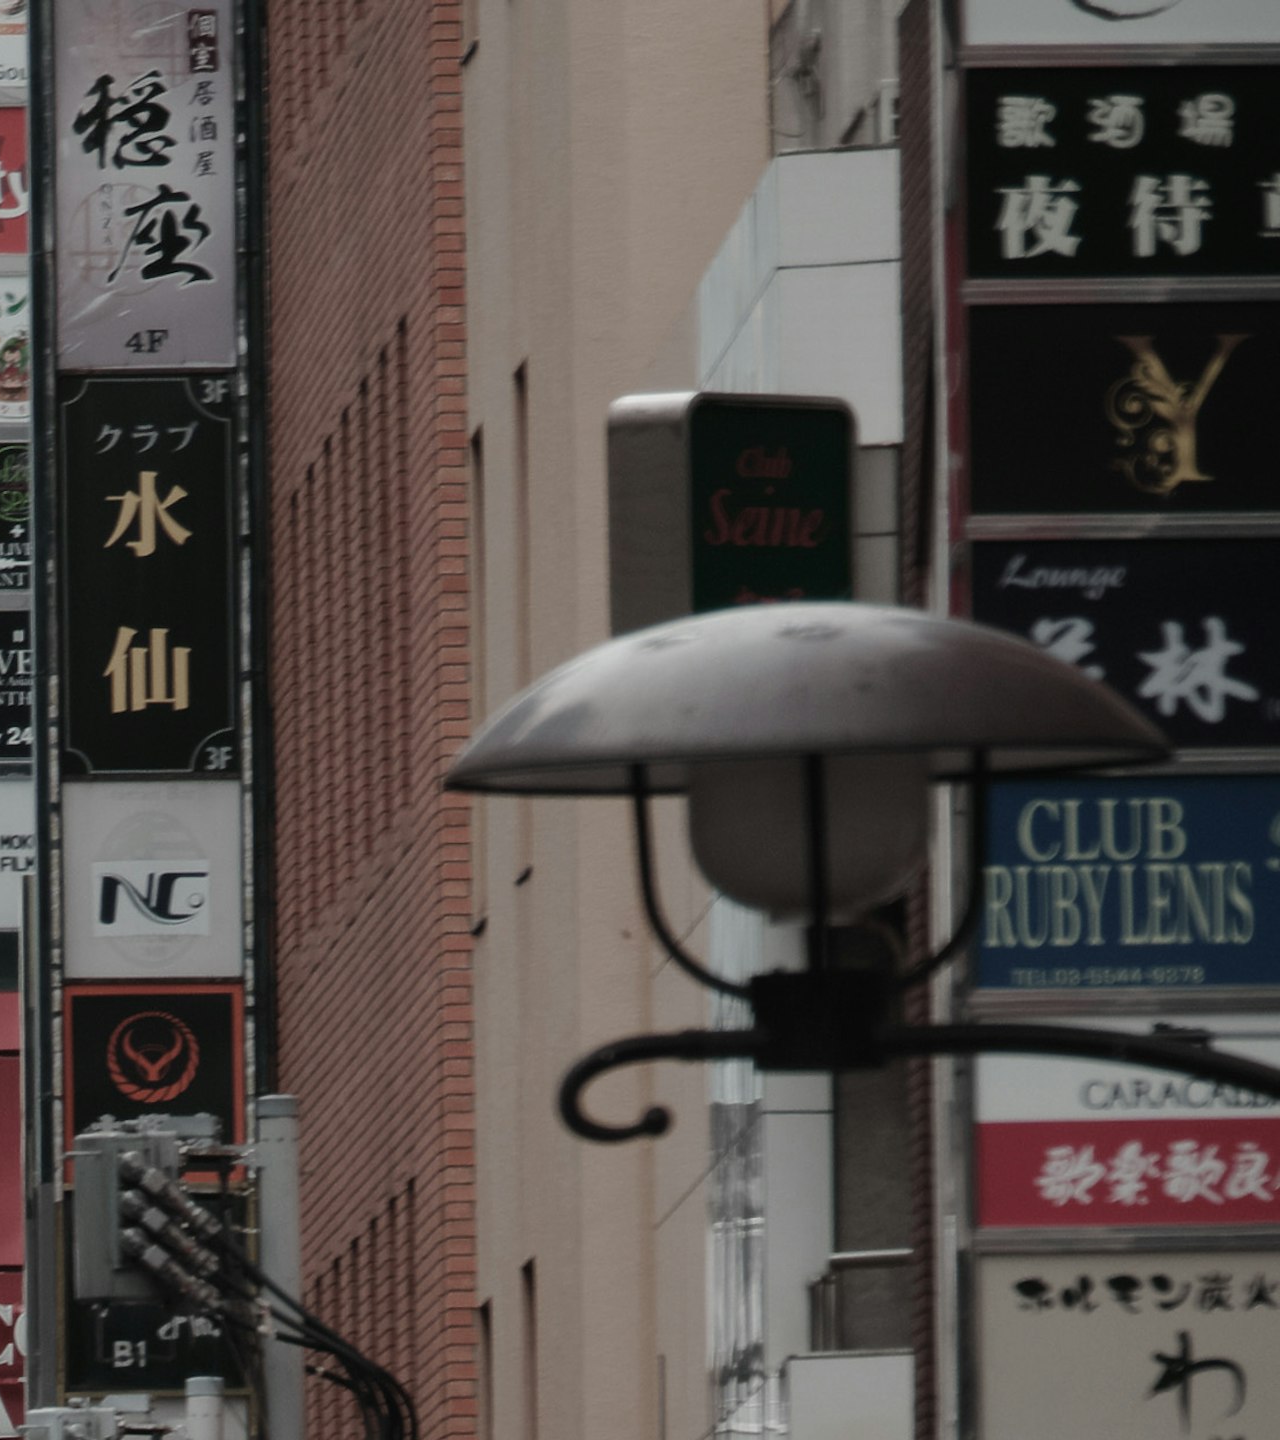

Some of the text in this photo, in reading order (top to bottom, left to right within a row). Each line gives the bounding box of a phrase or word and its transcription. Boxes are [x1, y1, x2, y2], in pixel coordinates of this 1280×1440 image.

[125, 329, 169, 353] 4F
[202, 380, 231, 403] 3F
[102, 470, 193, 714] 水仙
[999, 553, 1127, 600] Lounge
[204, 746, 233, 771] 3F
[1017, 796, 1188, 863] CLUB
[981, 861, 1256, 949] RUBY LENIS
